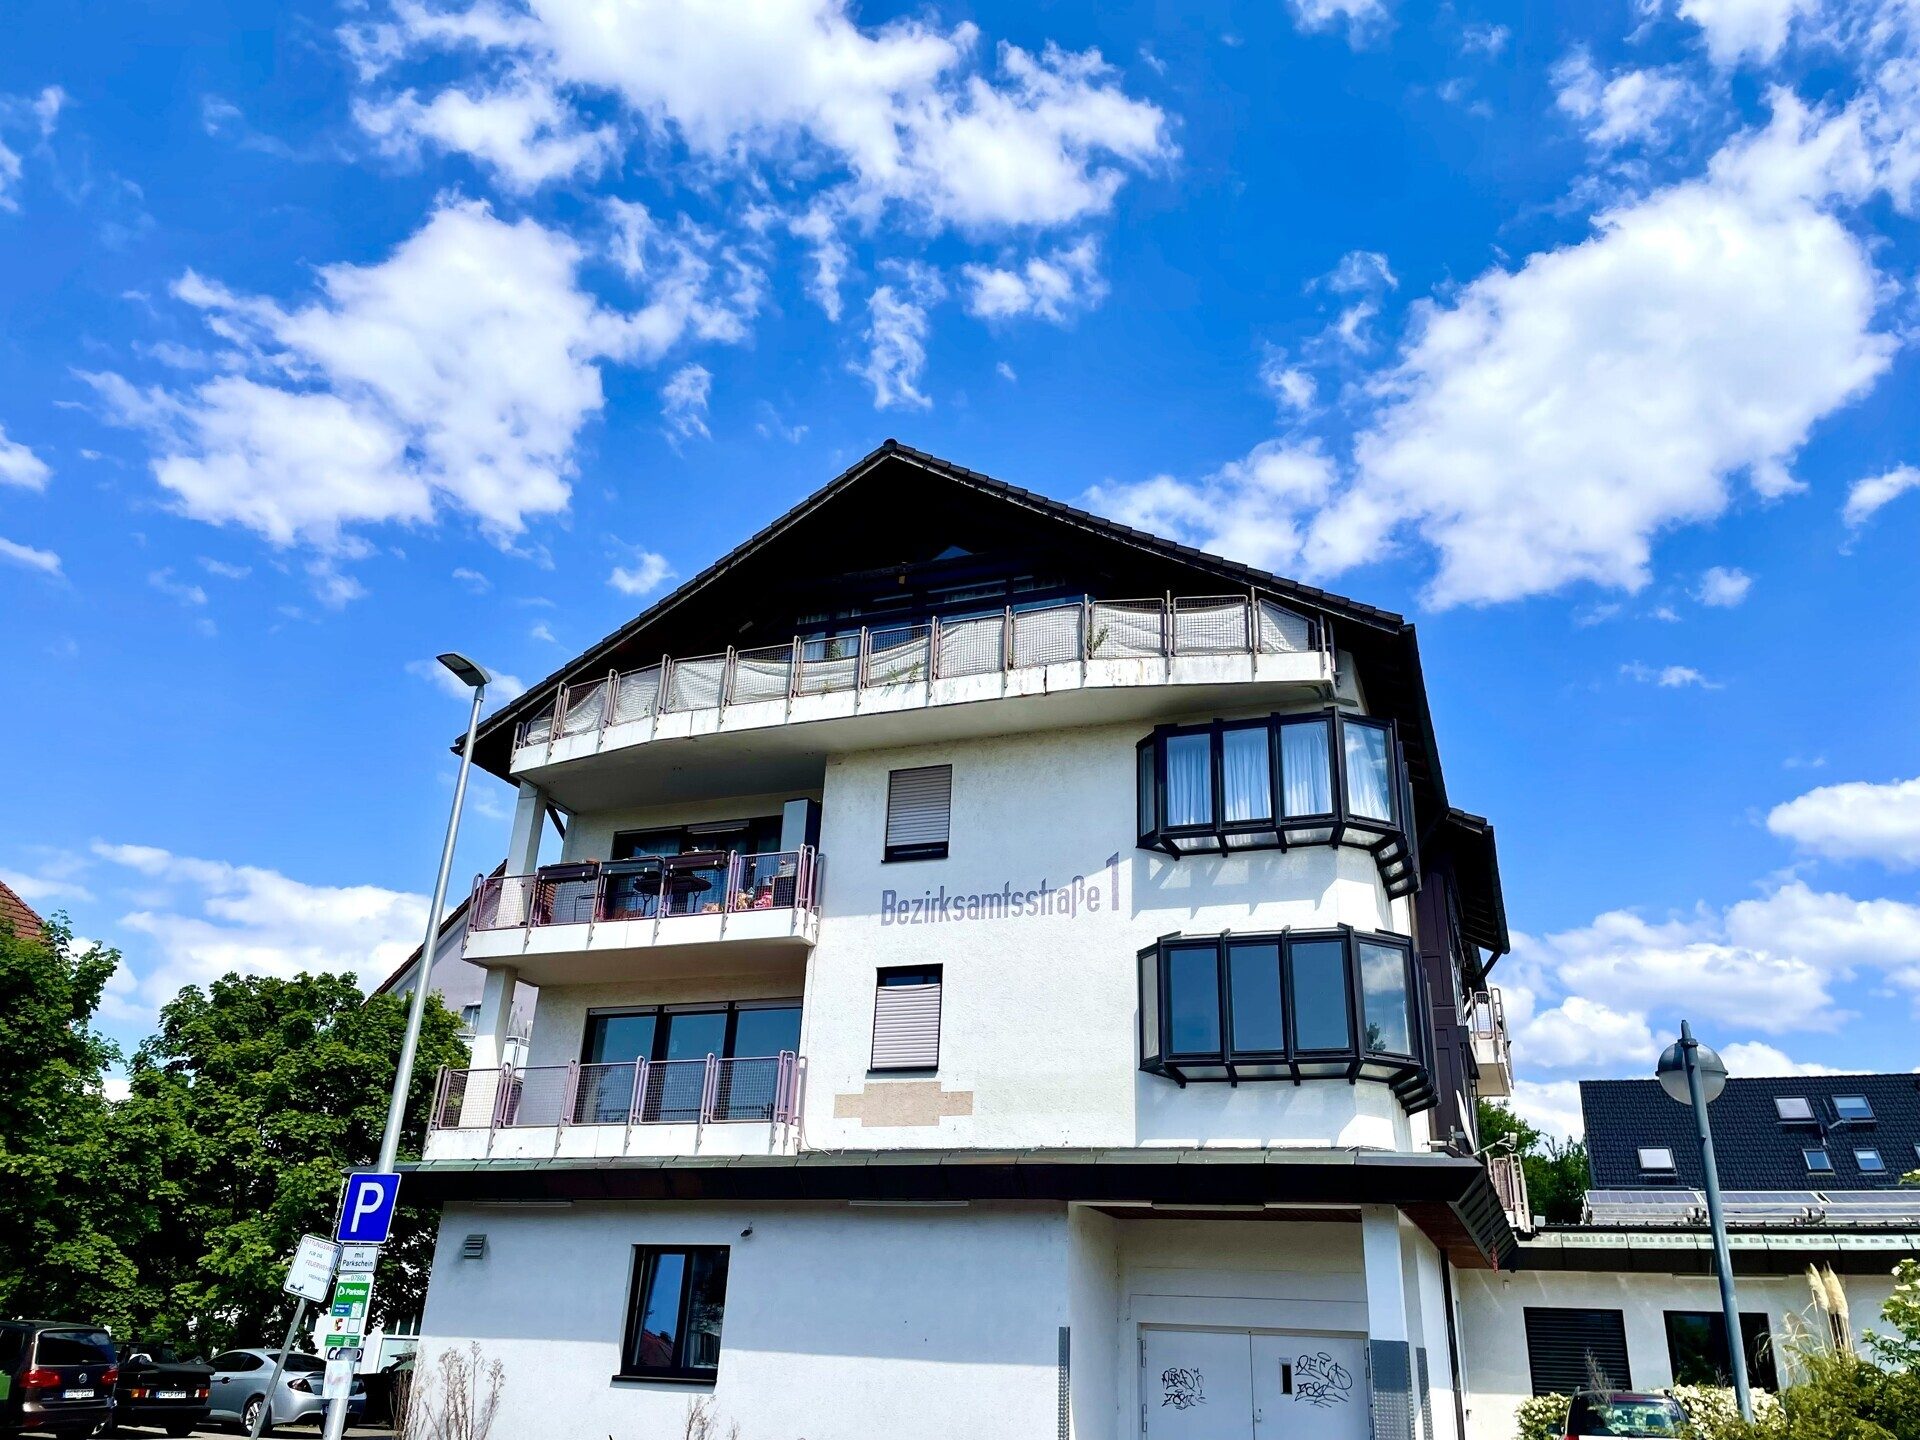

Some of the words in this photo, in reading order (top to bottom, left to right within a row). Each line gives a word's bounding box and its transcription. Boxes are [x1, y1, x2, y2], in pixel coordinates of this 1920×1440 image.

[881, 875, 1100, 926] Bezirksamtsstraße
[1105, 851, 1119, 911] 1
[350, 1182, 384, 1233] P
[342, 1259, 374, 1267] Parkschein
